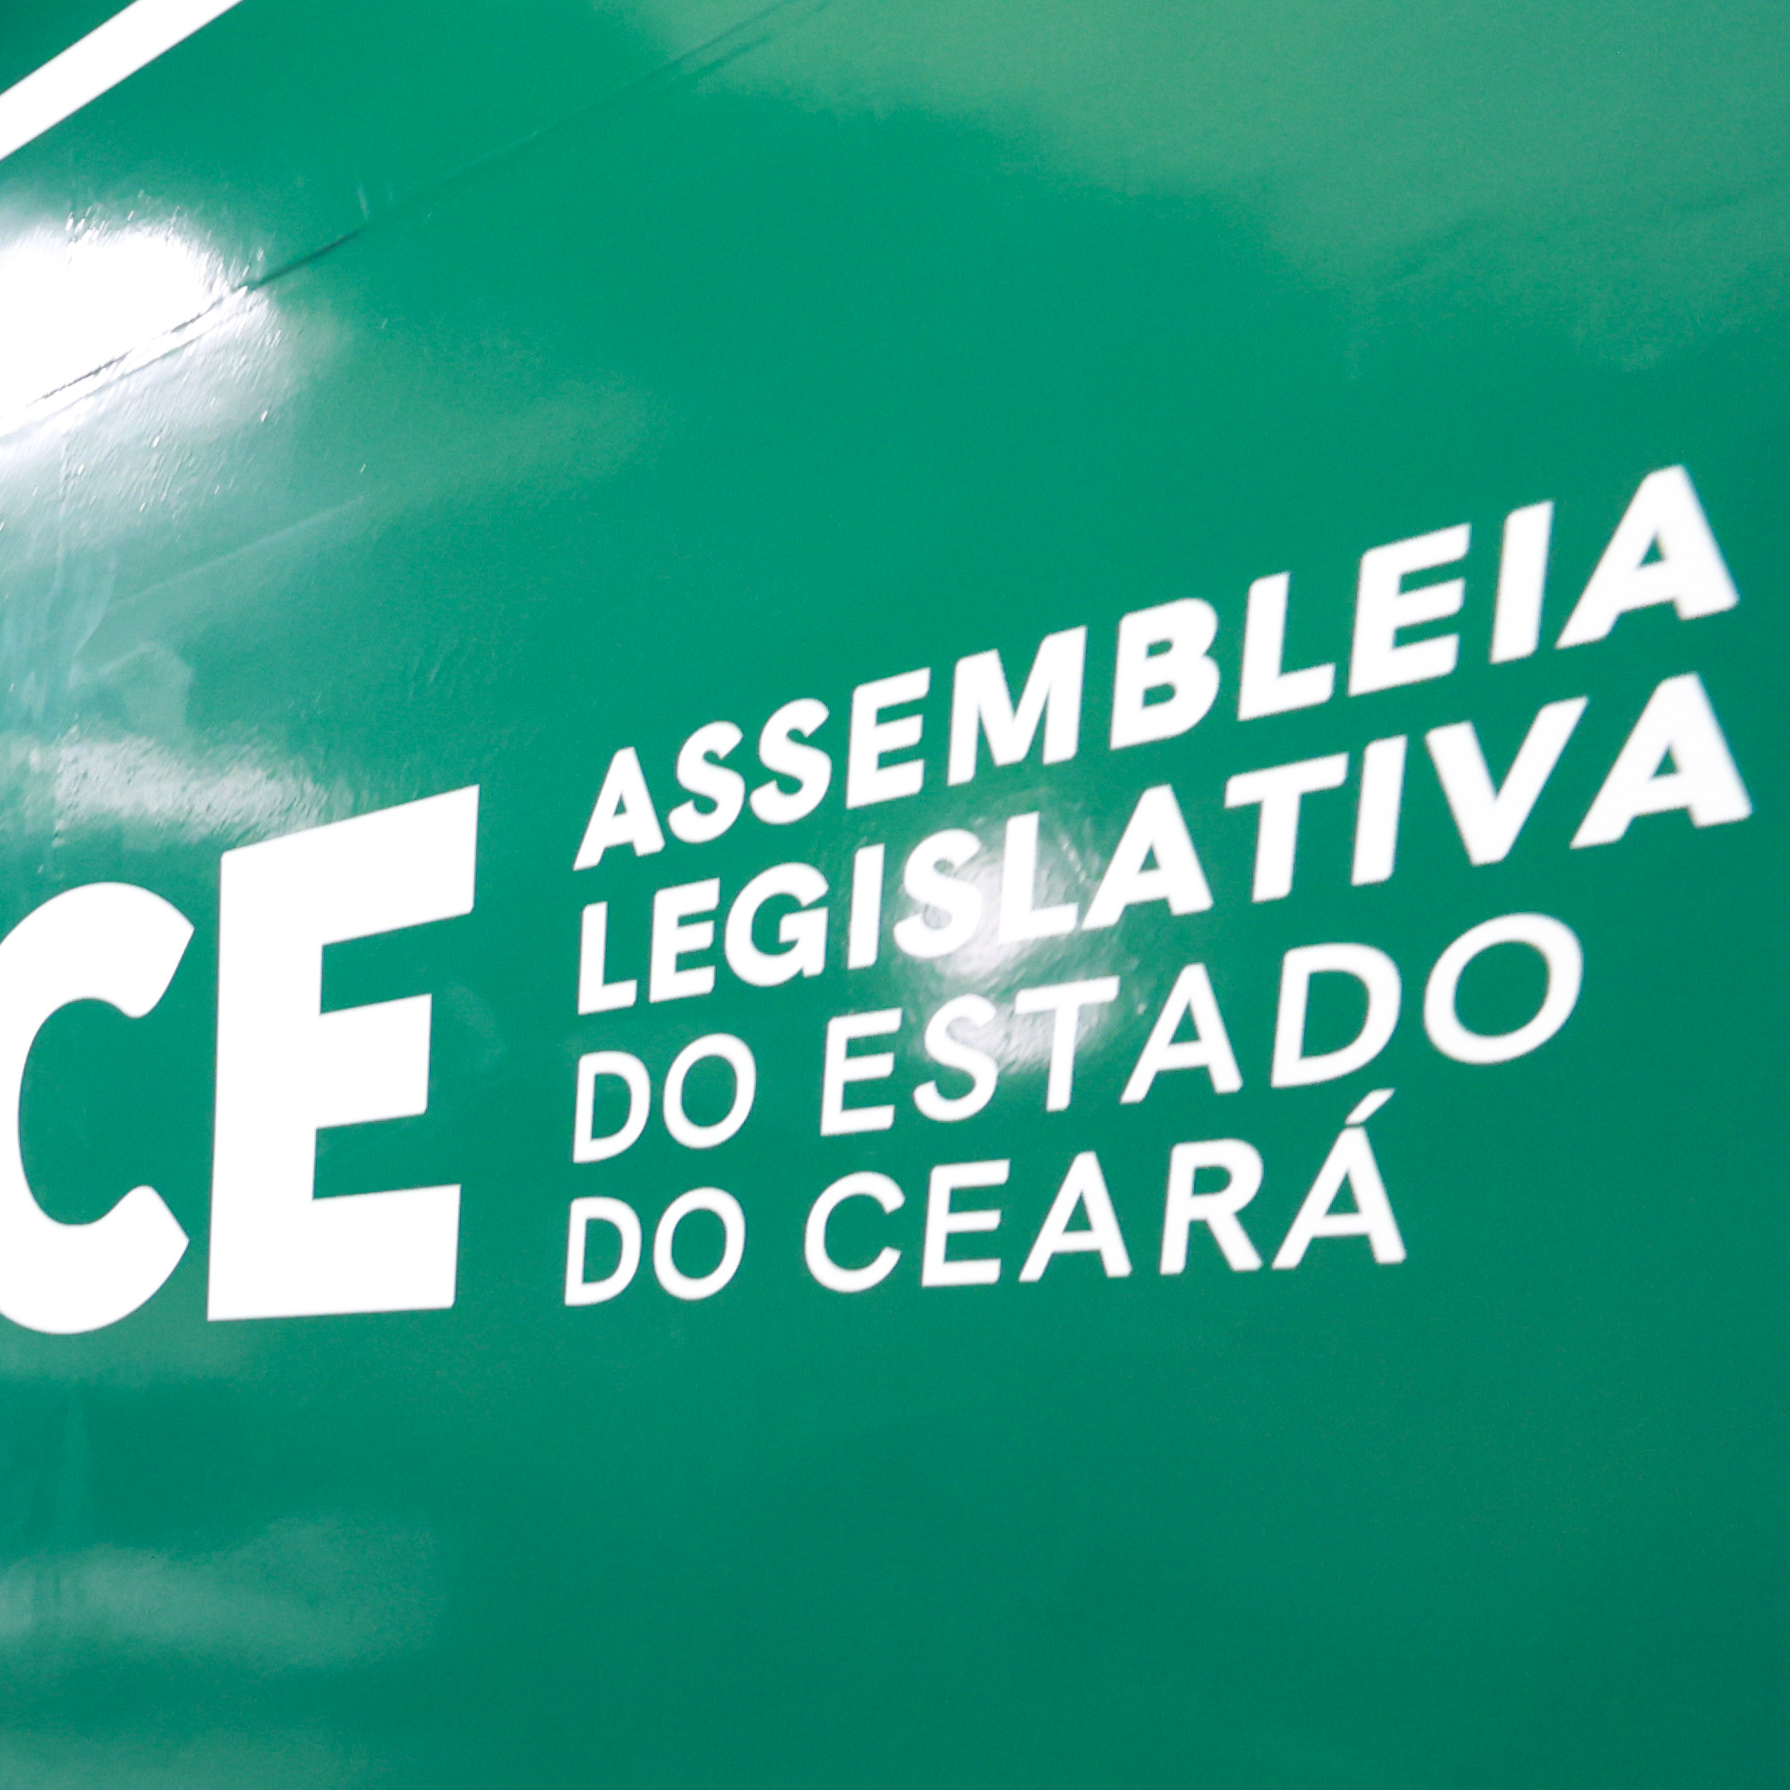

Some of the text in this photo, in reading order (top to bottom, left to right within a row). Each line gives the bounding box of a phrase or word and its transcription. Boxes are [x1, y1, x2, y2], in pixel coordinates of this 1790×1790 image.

[574, 464, 1739, 870] ASSEMBLEIA
[577, 671, 1753, 1014] LEGISLATIVA
[573, 912, 1584, 1163] DO ESTADO
[564, 1088, 1407, 1306] DO CEARÁ
